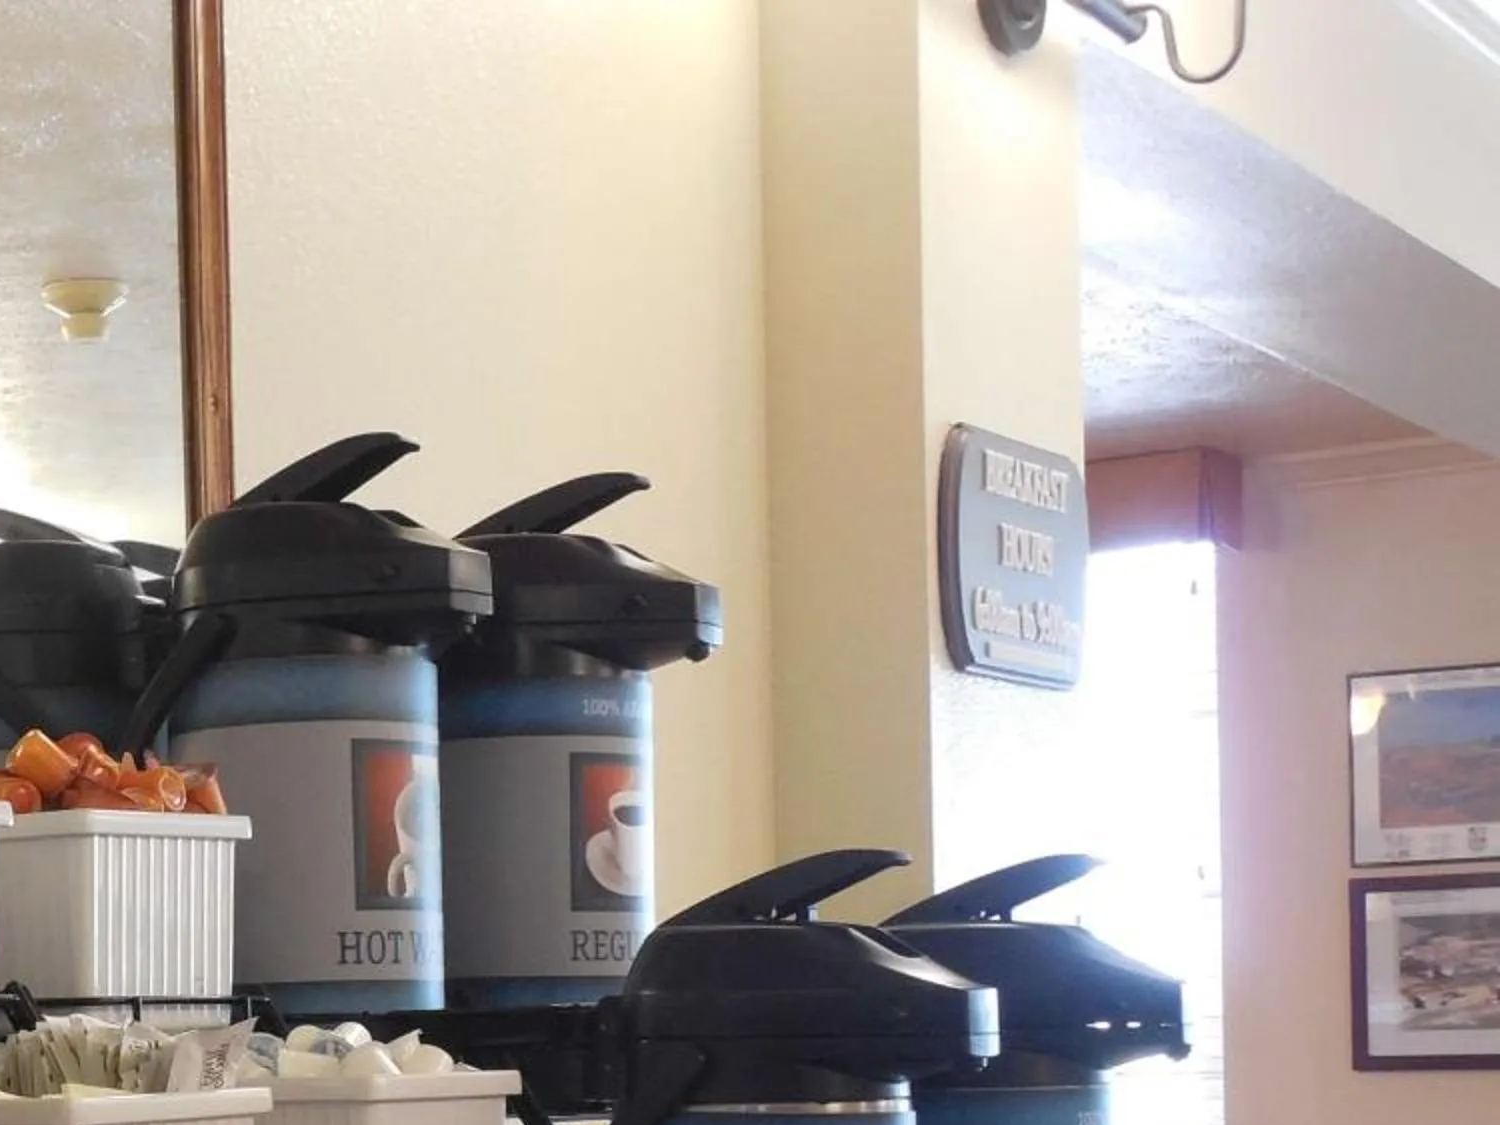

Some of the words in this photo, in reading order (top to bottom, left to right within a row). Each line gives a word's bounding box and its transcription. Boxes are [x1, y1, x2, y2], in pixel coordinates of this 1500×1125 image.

[983, 450, 1069, 513] BREAKFAST
[999, 522, 1054, 577] HOURS
[581, 698, 620, 718] 100%
[337, 929, 404, 965] HOT
